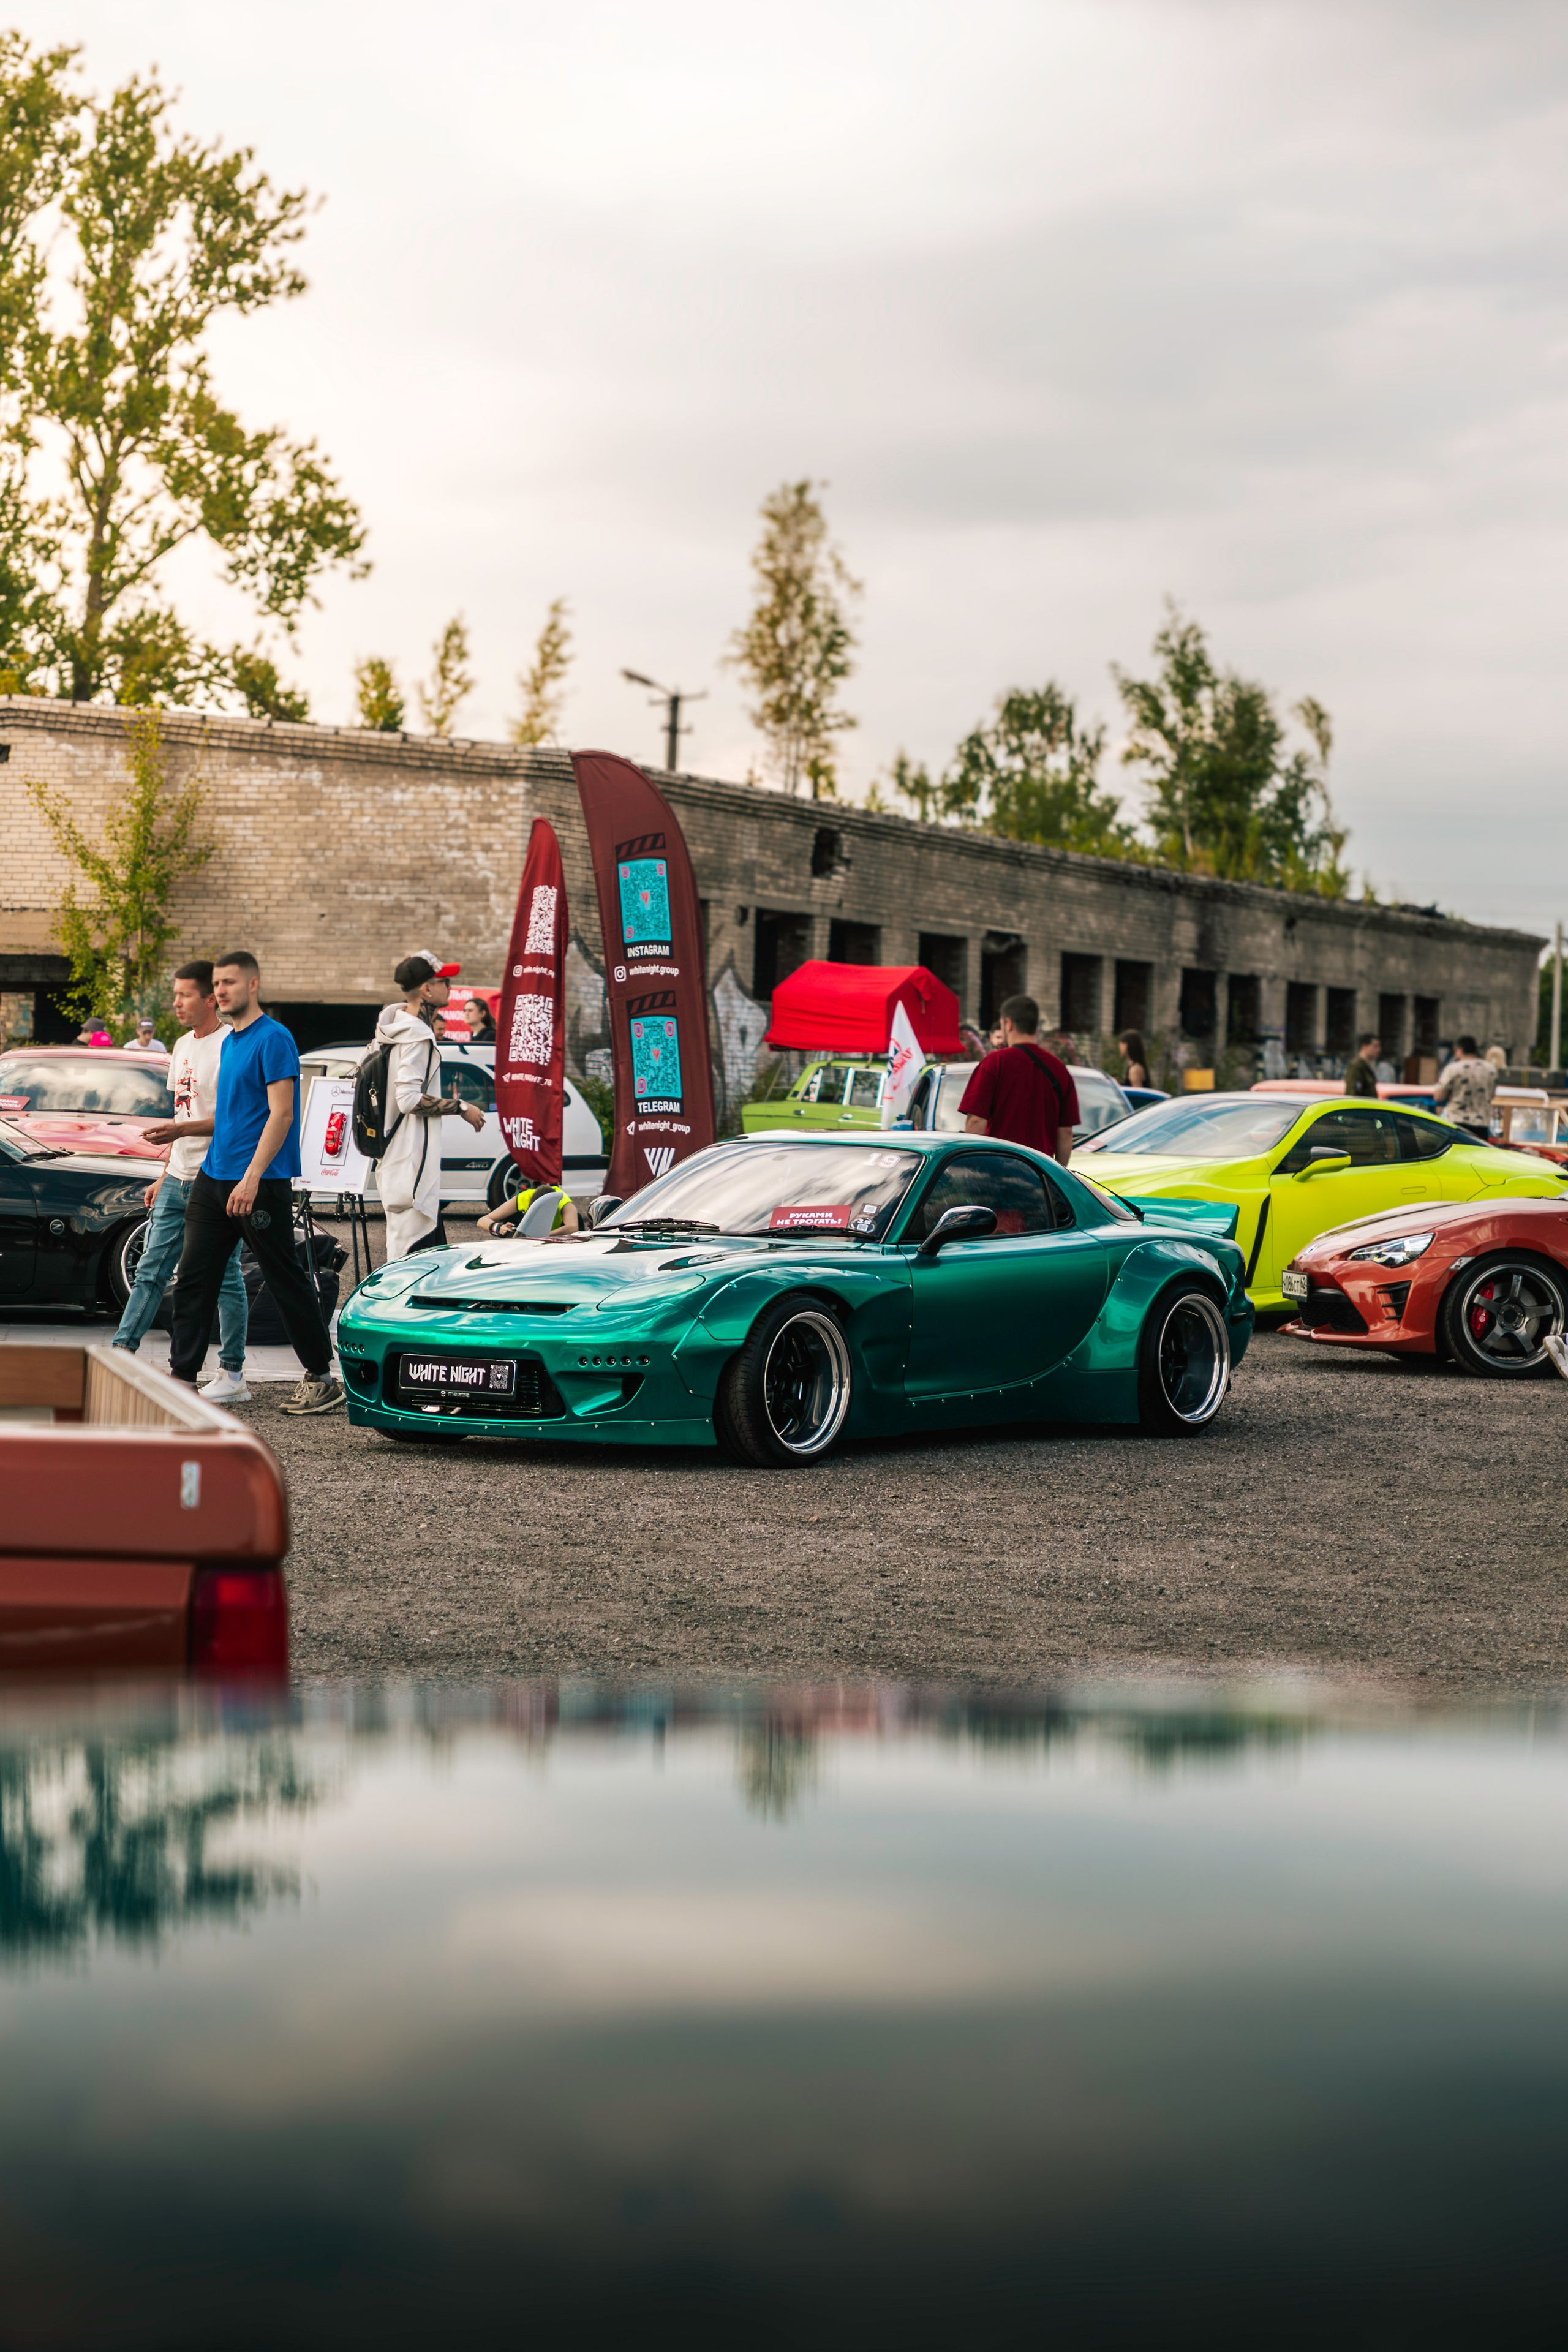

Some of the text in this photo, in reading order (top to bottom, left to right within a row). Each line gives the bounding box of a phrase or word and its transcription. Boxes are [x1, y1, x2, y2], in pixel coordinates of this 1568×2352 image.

[627, 944, 669, 957] INSTAGRAM
[637, 1101, 680, 1113] TELEGRAM
[503, 1117, 533, 1135] WHITE
[638, 1120, 691, 1134] whitenight_group
[512, 1133, 541, 1152] NIGHT
[861, 1152, 902, 1169] 19
[409, 1363, 486, 1385] WHITE NIGHT
